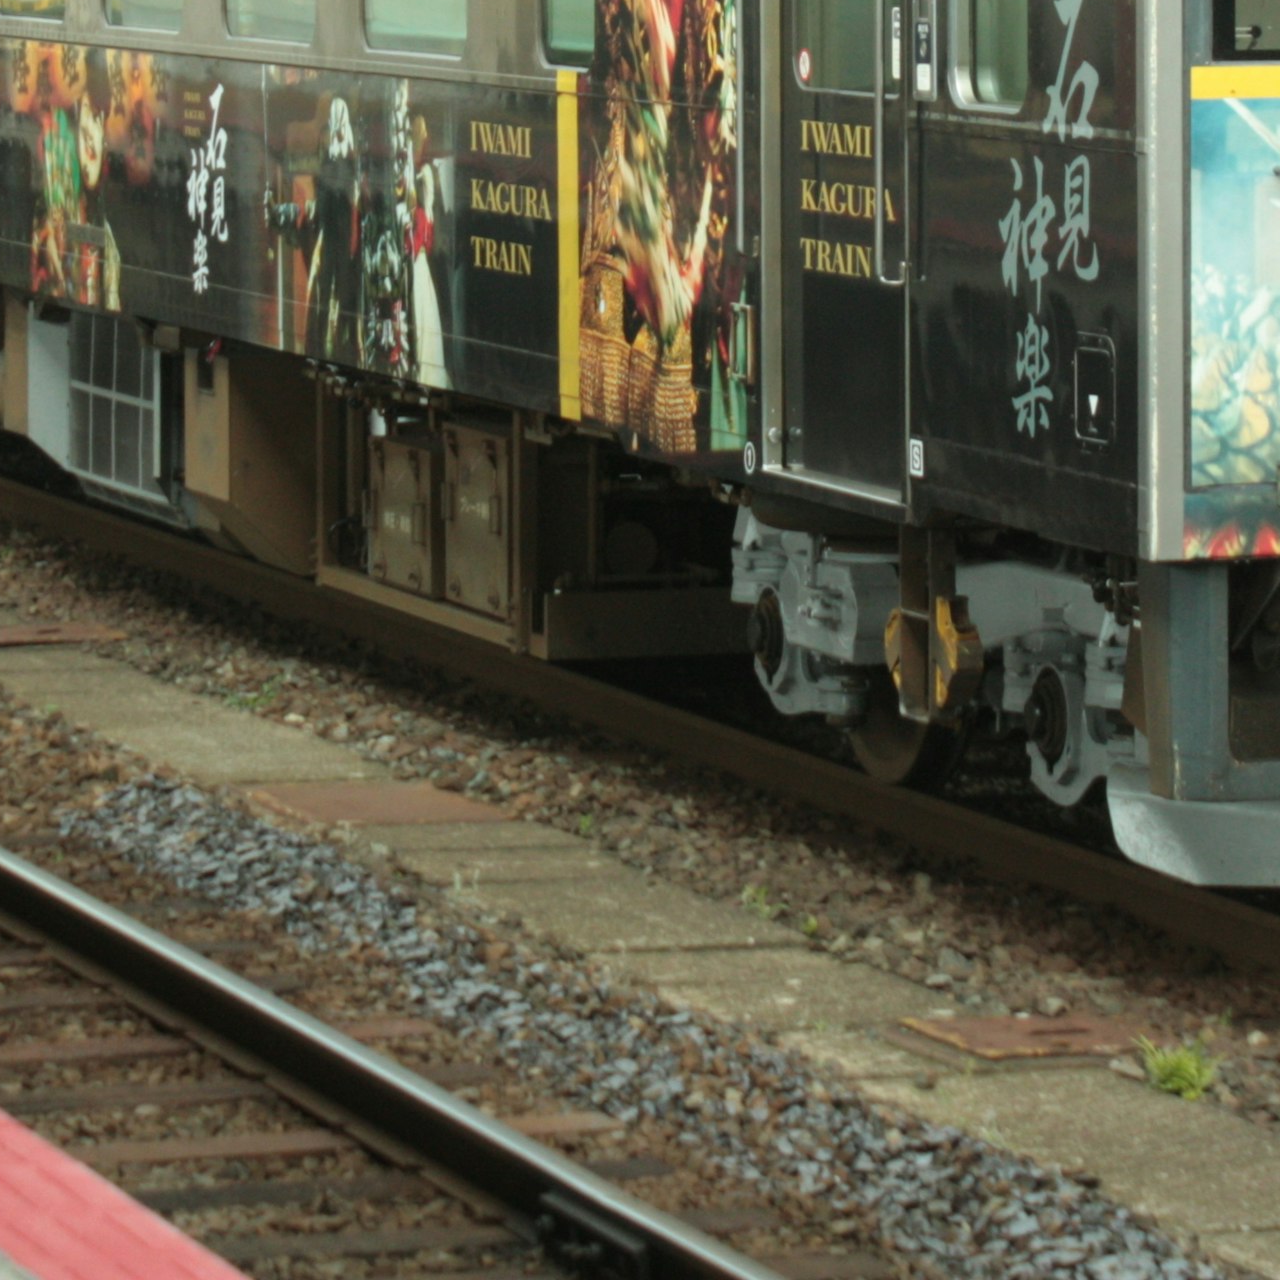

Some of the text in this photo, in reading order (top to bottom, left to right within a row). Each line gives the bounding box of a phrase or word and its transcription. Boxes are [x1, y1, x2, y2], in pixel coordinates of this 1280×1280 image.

[470, 120, 532, 158] IWAMI
[800, 120, 873, 158] IWAMI
[471, 178, 552, 221] KAGURA
[470, 235, 532, 276] TRAIN
[800, 237, 872, 278] TRAIN
